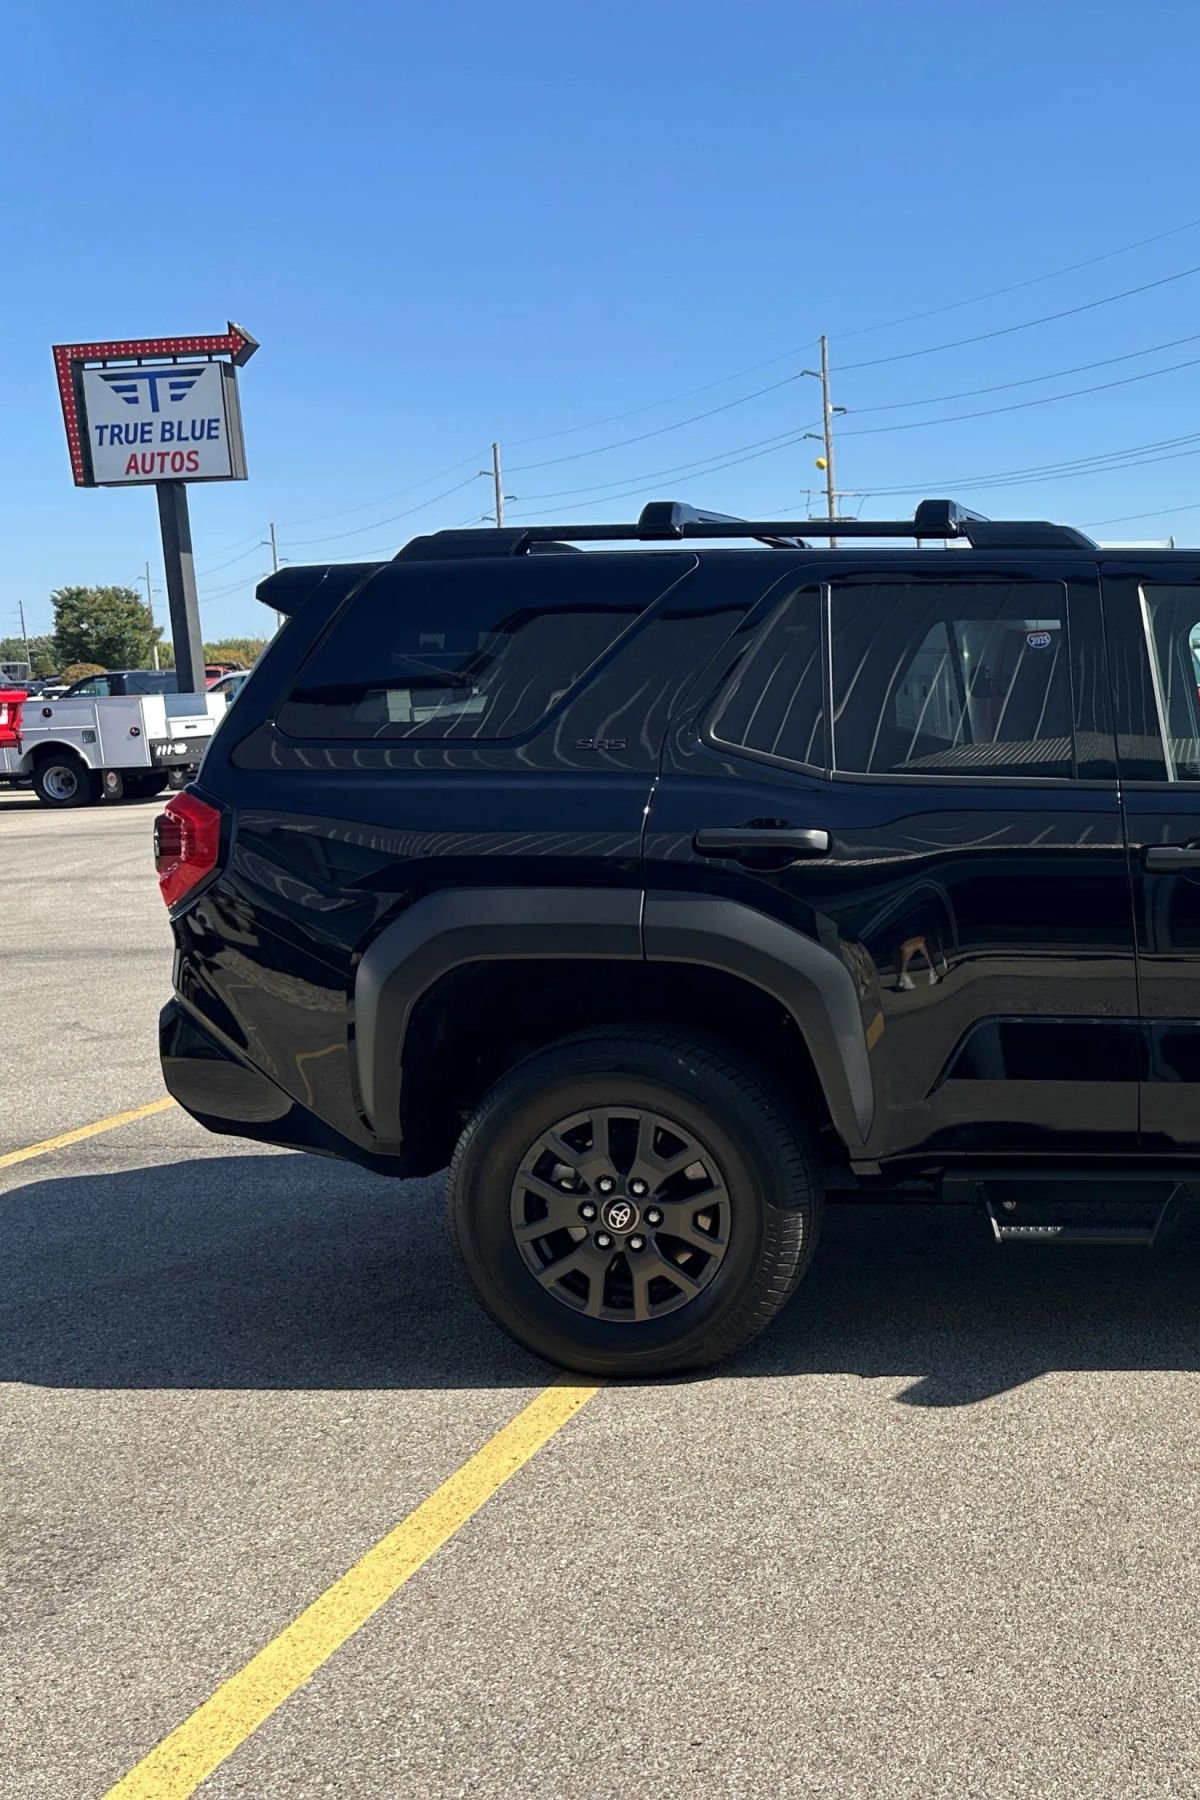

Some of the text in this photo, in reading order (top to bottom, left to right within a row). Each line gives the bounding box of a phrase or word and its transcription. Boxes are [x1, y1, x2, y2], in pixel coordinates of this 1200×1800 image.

[95, 418, 220, 446] TRUE BLUE
[125, 450, 199, 475] AUTOS
